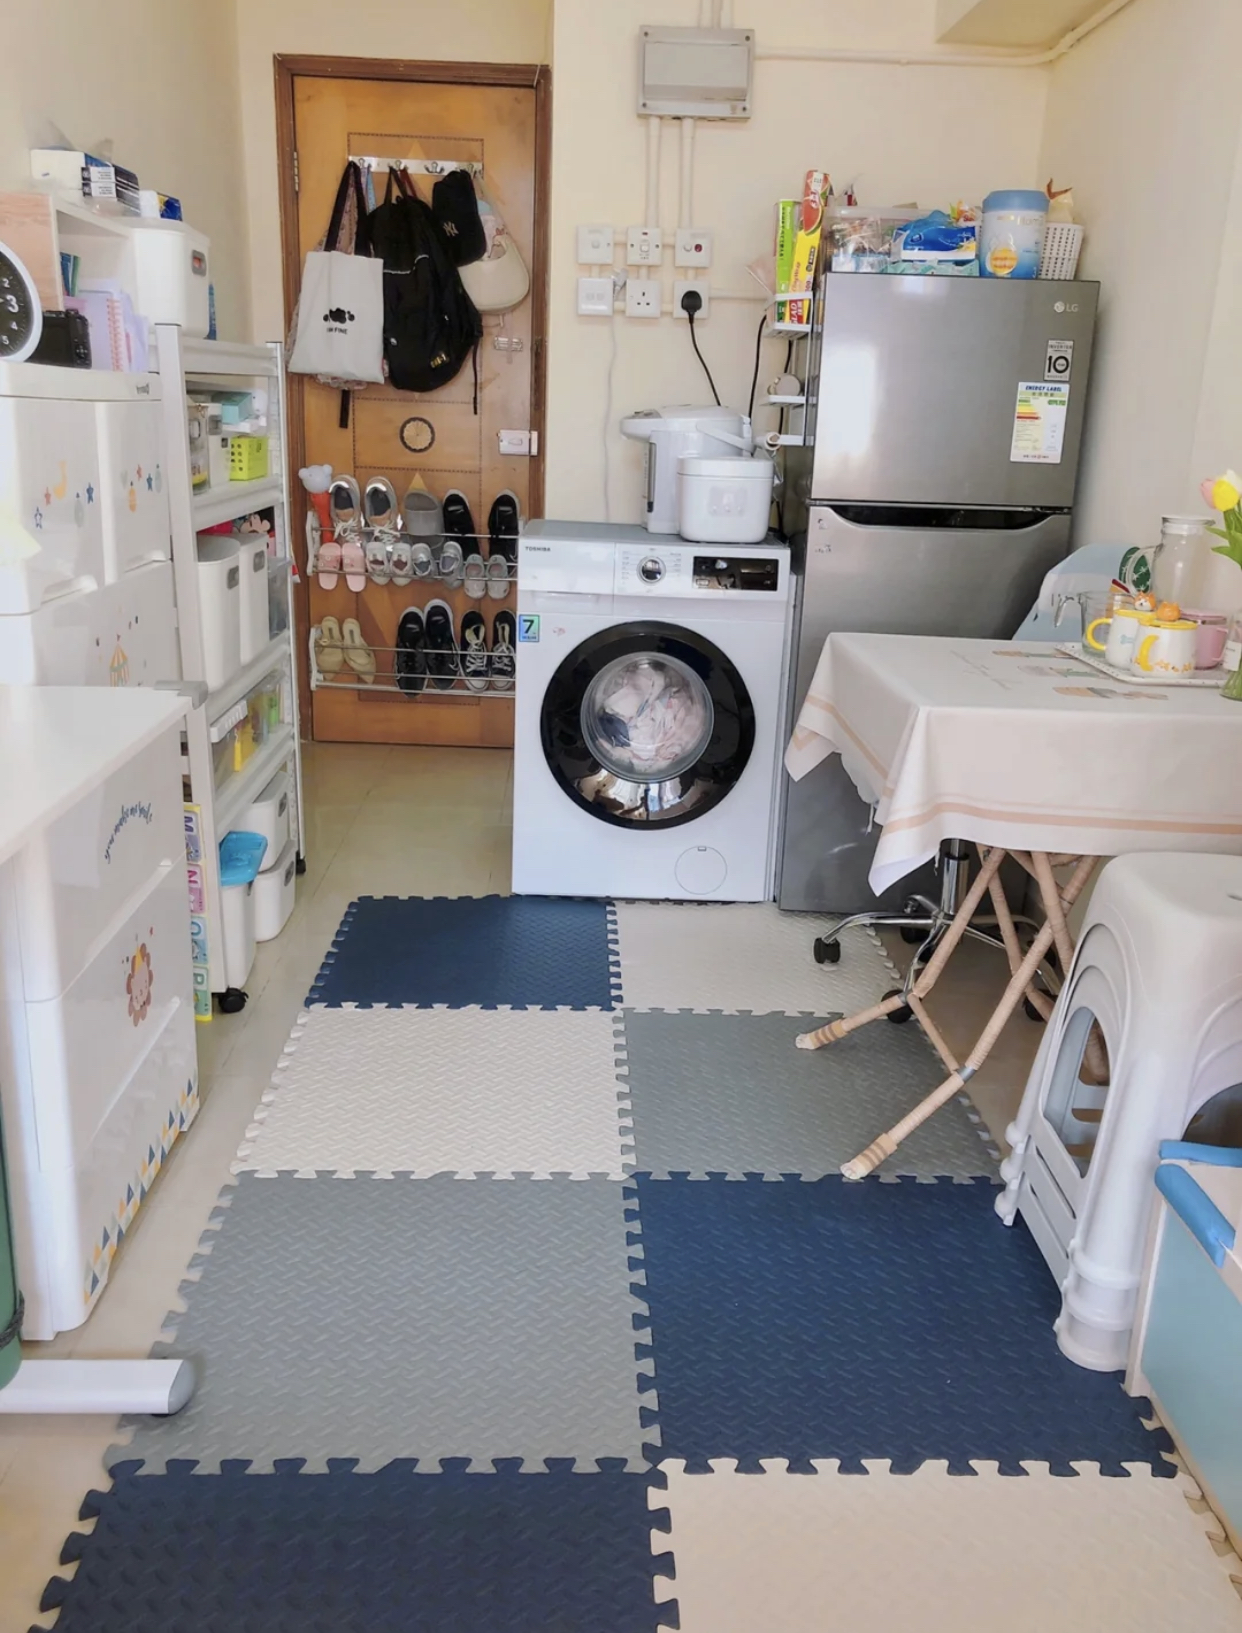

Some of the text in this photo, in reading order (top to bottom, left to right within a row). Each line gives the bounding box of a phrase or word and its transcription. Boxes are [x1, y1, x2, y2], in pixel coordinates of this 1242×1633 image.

[3, 278, 10, 288] 2
[6, 294, 19, 313] 3
[1066, 303, 1079, 312] LG
[11, 321, 18, 331] 4
[2, 335, 10, 345] 5
[1047, 355, 1070, 374] 10
[1046, 385, 1062, 393] LABEL
[522, 618, 535, 634] 7
